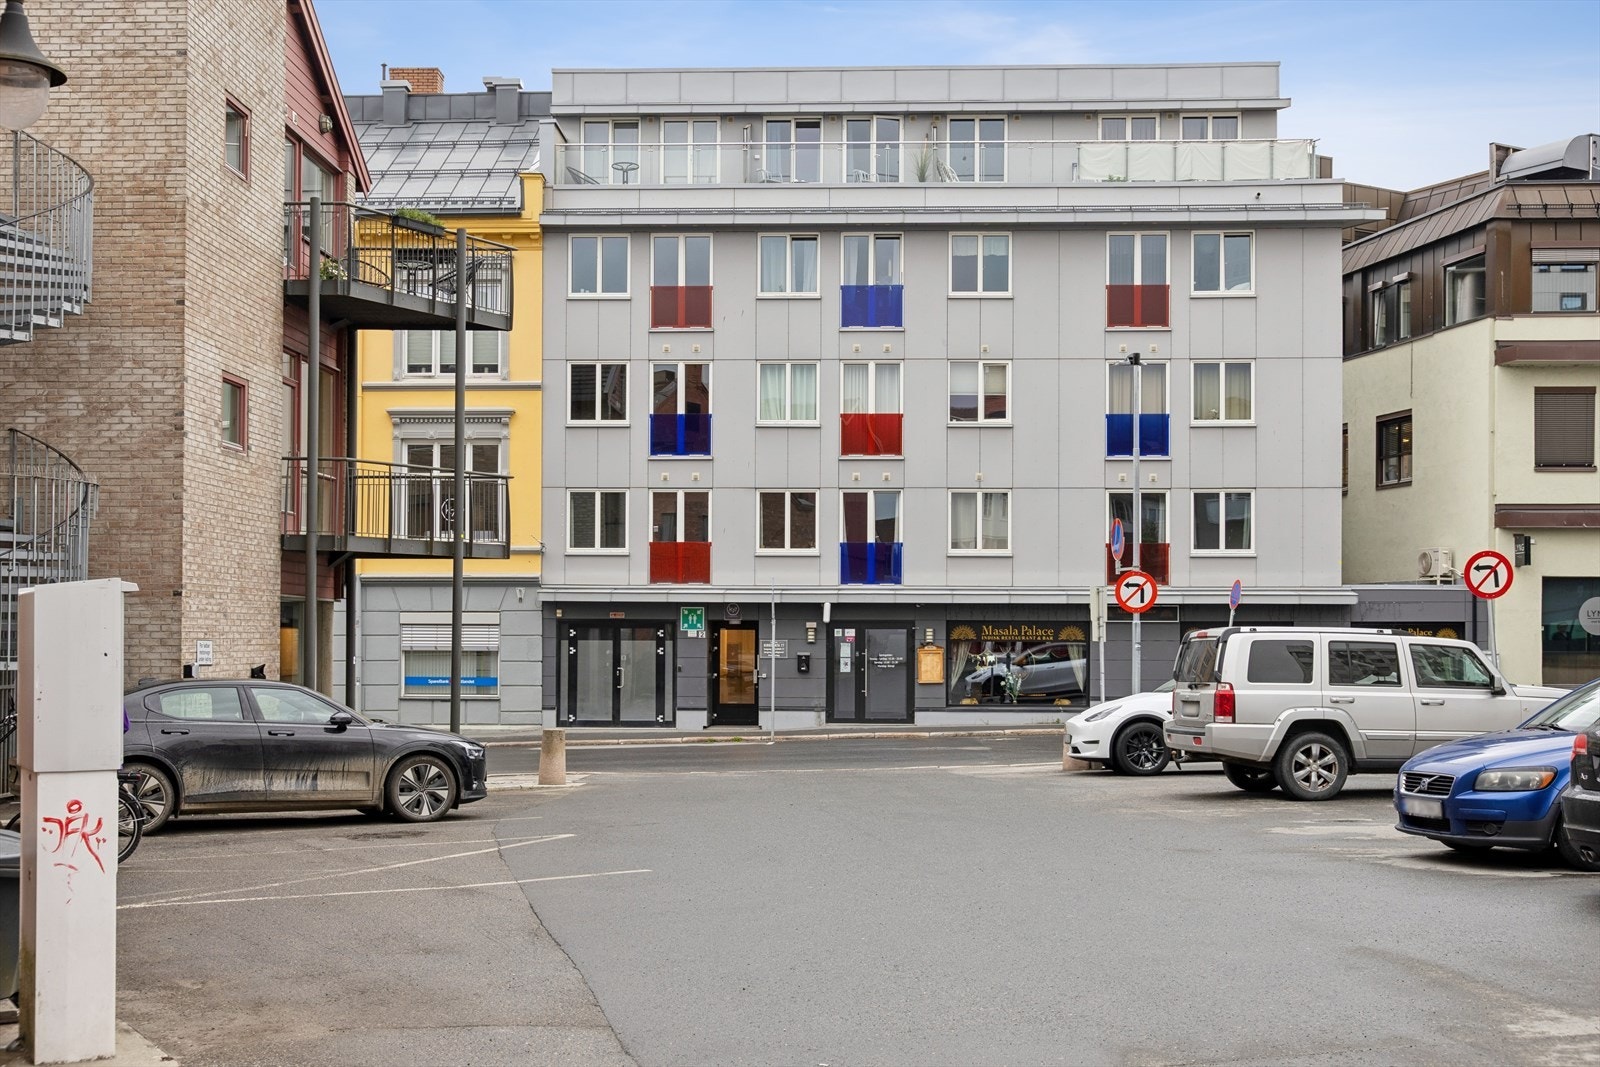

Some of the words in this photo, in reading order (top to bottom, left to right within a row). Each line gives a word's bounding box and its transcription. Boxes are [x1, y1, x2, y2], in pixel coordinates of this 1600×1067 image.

[982, 625, 1019, 636] Masala
[1021, 625, 1055, 636] Palace
[1408, 628, 1433, 636] Palace
